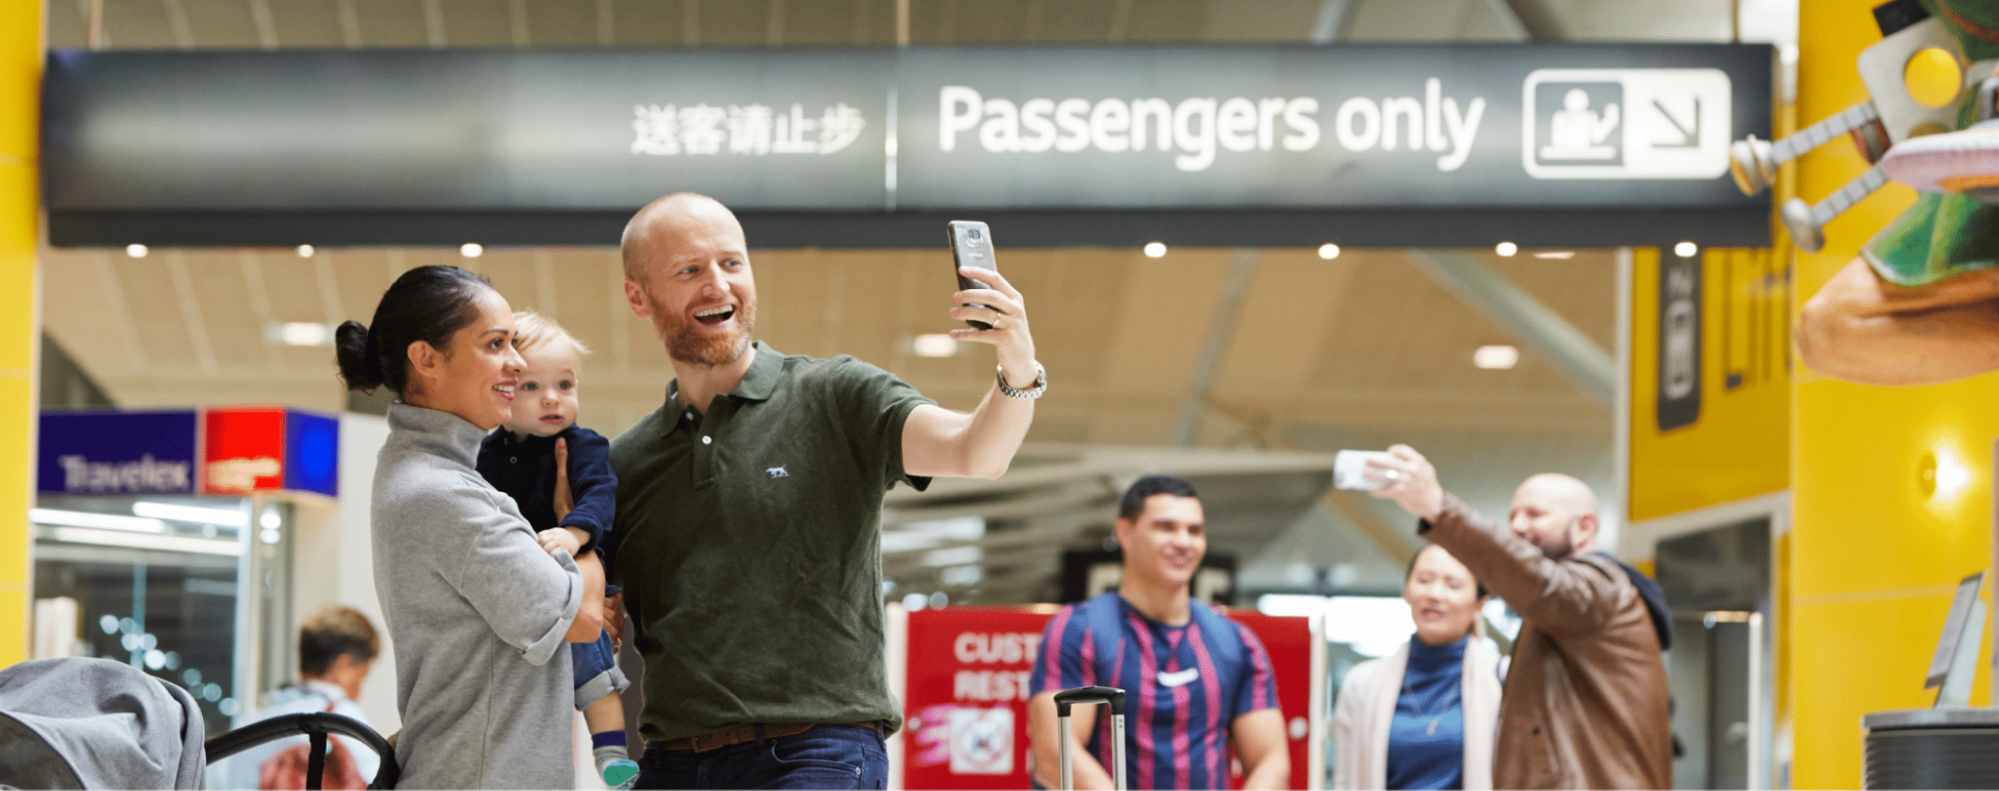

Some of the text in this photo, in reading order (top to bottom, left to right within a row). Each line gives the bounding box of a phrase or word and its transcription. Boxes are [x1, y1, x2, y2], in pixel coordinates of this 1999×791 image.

[631, 103, 865, 155] 送客请止步
[939, 77, 1486, 172] Passengers only
[60, 454, 190, 490] Travelex
